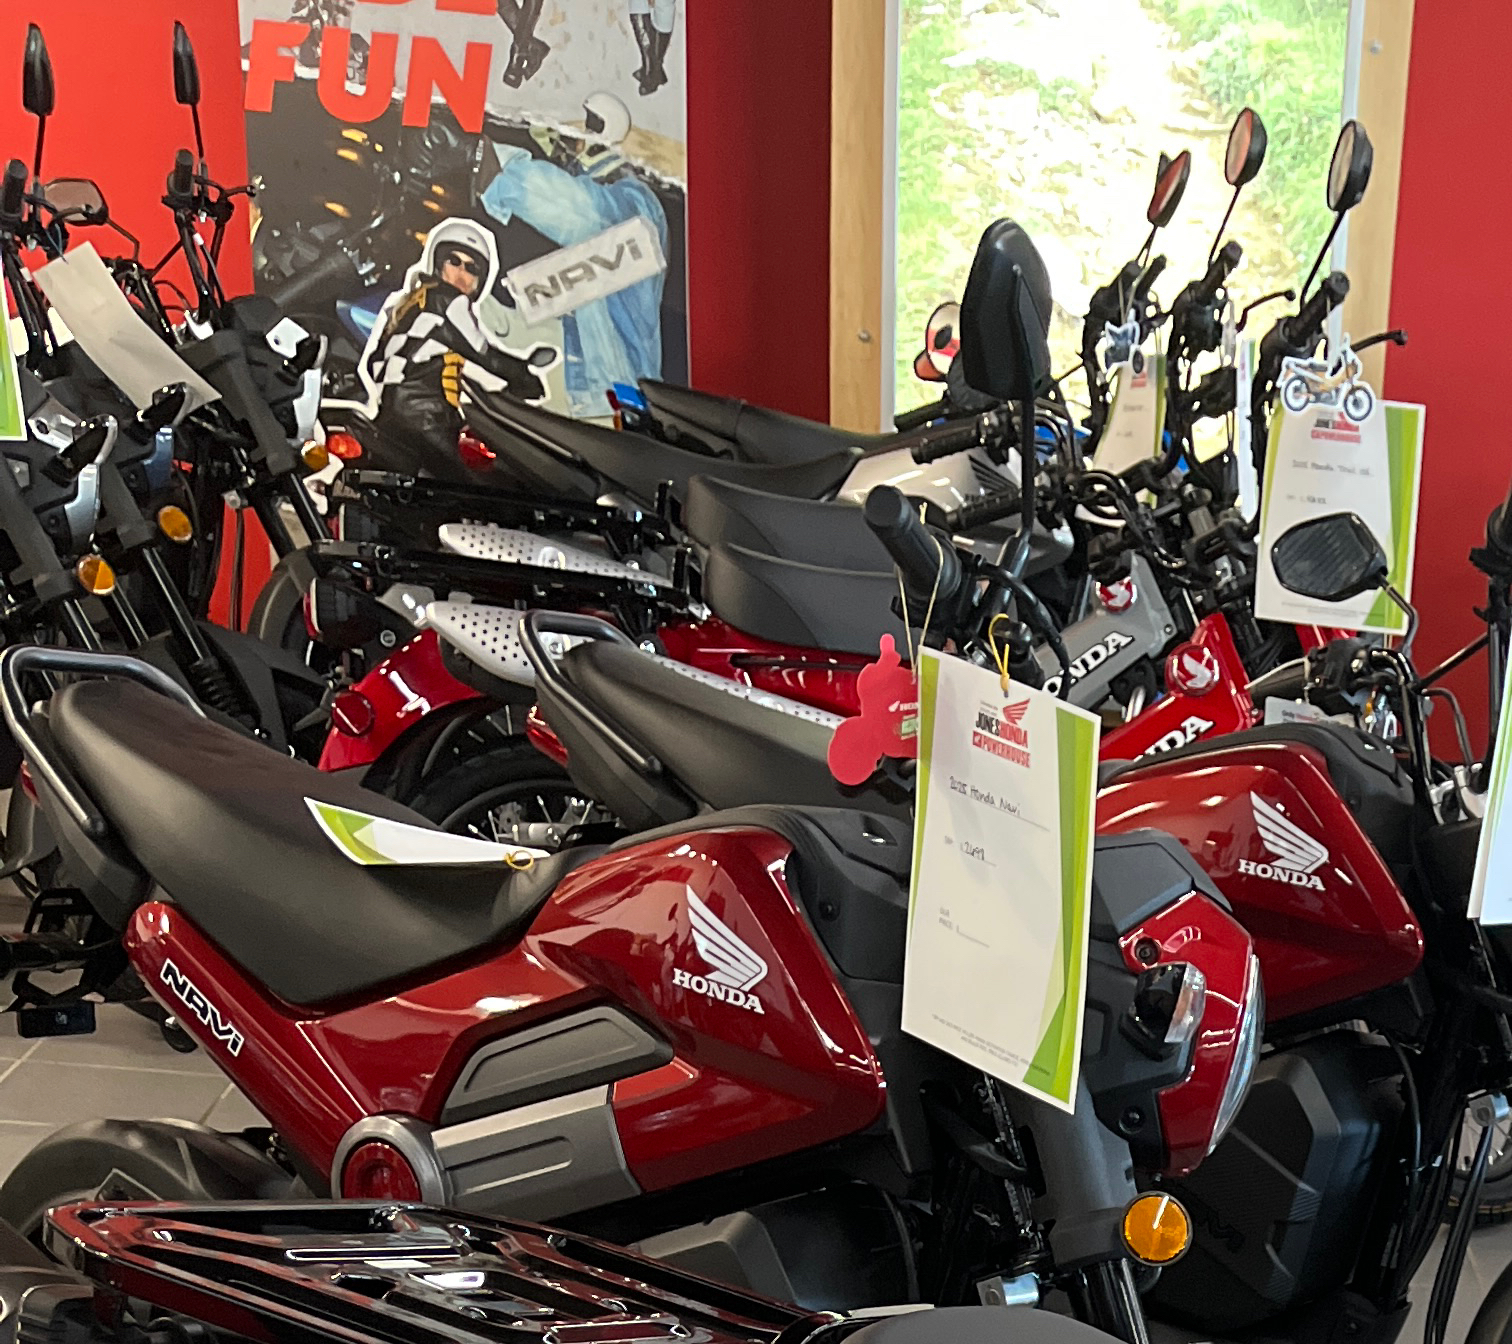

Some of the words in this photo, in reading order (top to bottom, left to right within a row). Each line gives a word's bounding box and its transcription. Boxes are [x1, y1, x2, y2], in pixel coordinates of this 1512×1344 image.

[244, 19, 493, 133] FUN
[1042, 630, 1135, 697] ONDA
[1238, 858, 1327, 892] HONDA
[672, 967, 765, 1015] HONDA
